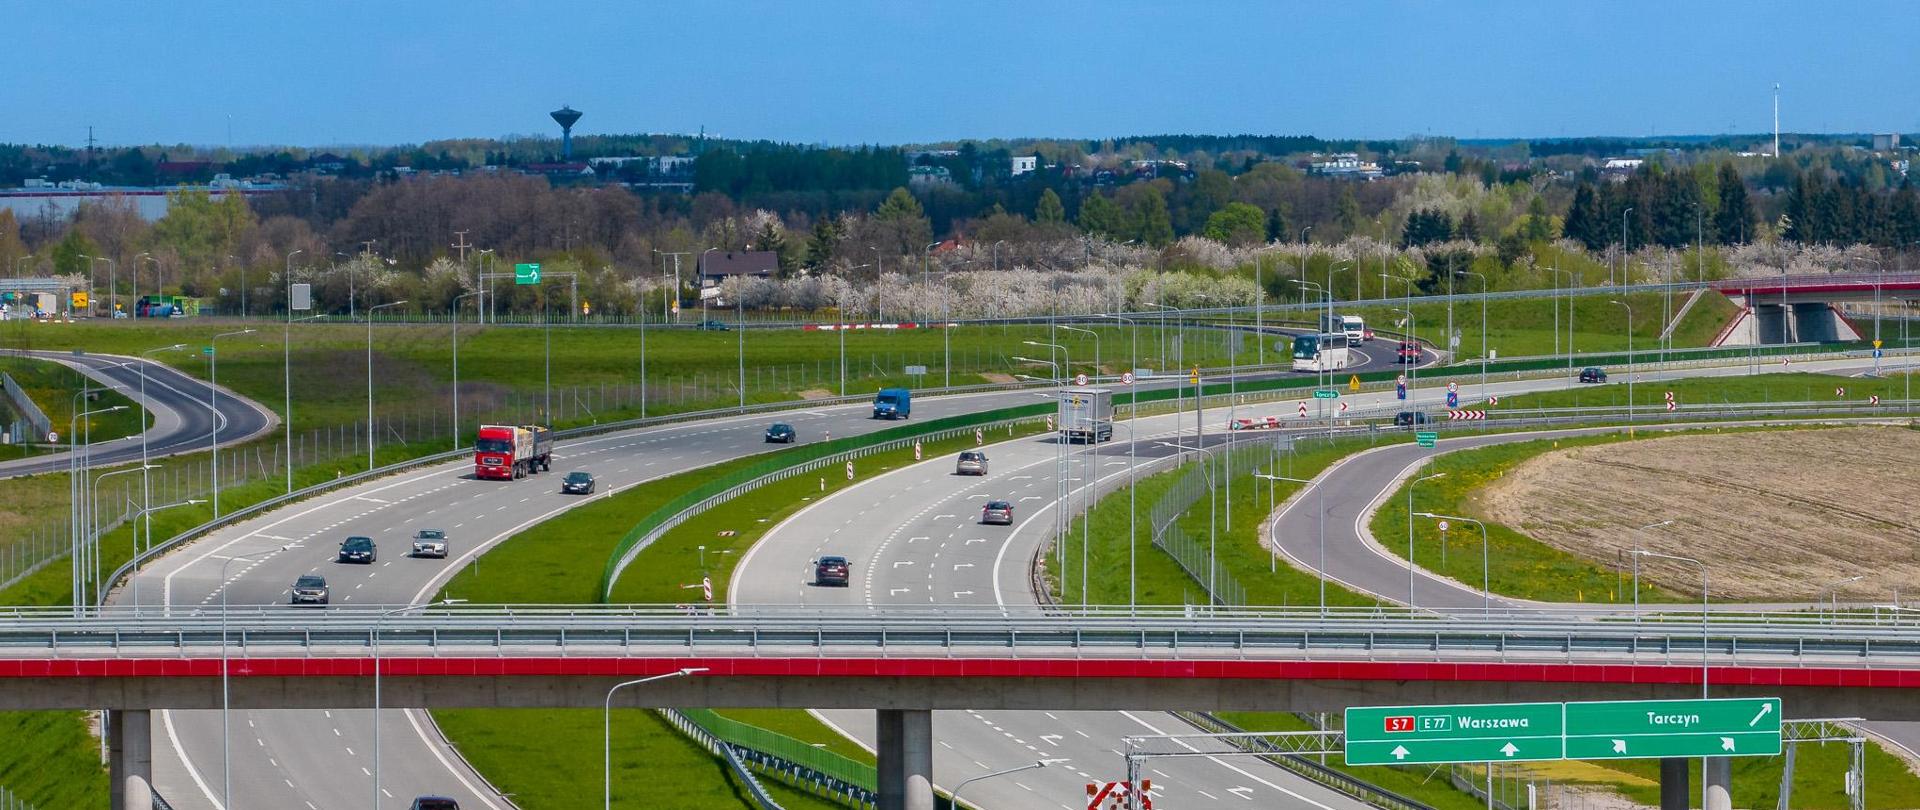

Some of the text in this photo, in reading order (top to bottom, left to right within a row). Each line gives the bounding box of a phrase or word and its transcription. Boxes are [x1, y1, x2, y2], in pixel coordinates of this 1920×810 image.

[1424, 718, 1431, 729] E
[1433, 718, 1446, 729] 77
[1457, 716, 1529, 729] Warszawa
[1647, 711, 1700, 728] Tarczyn
